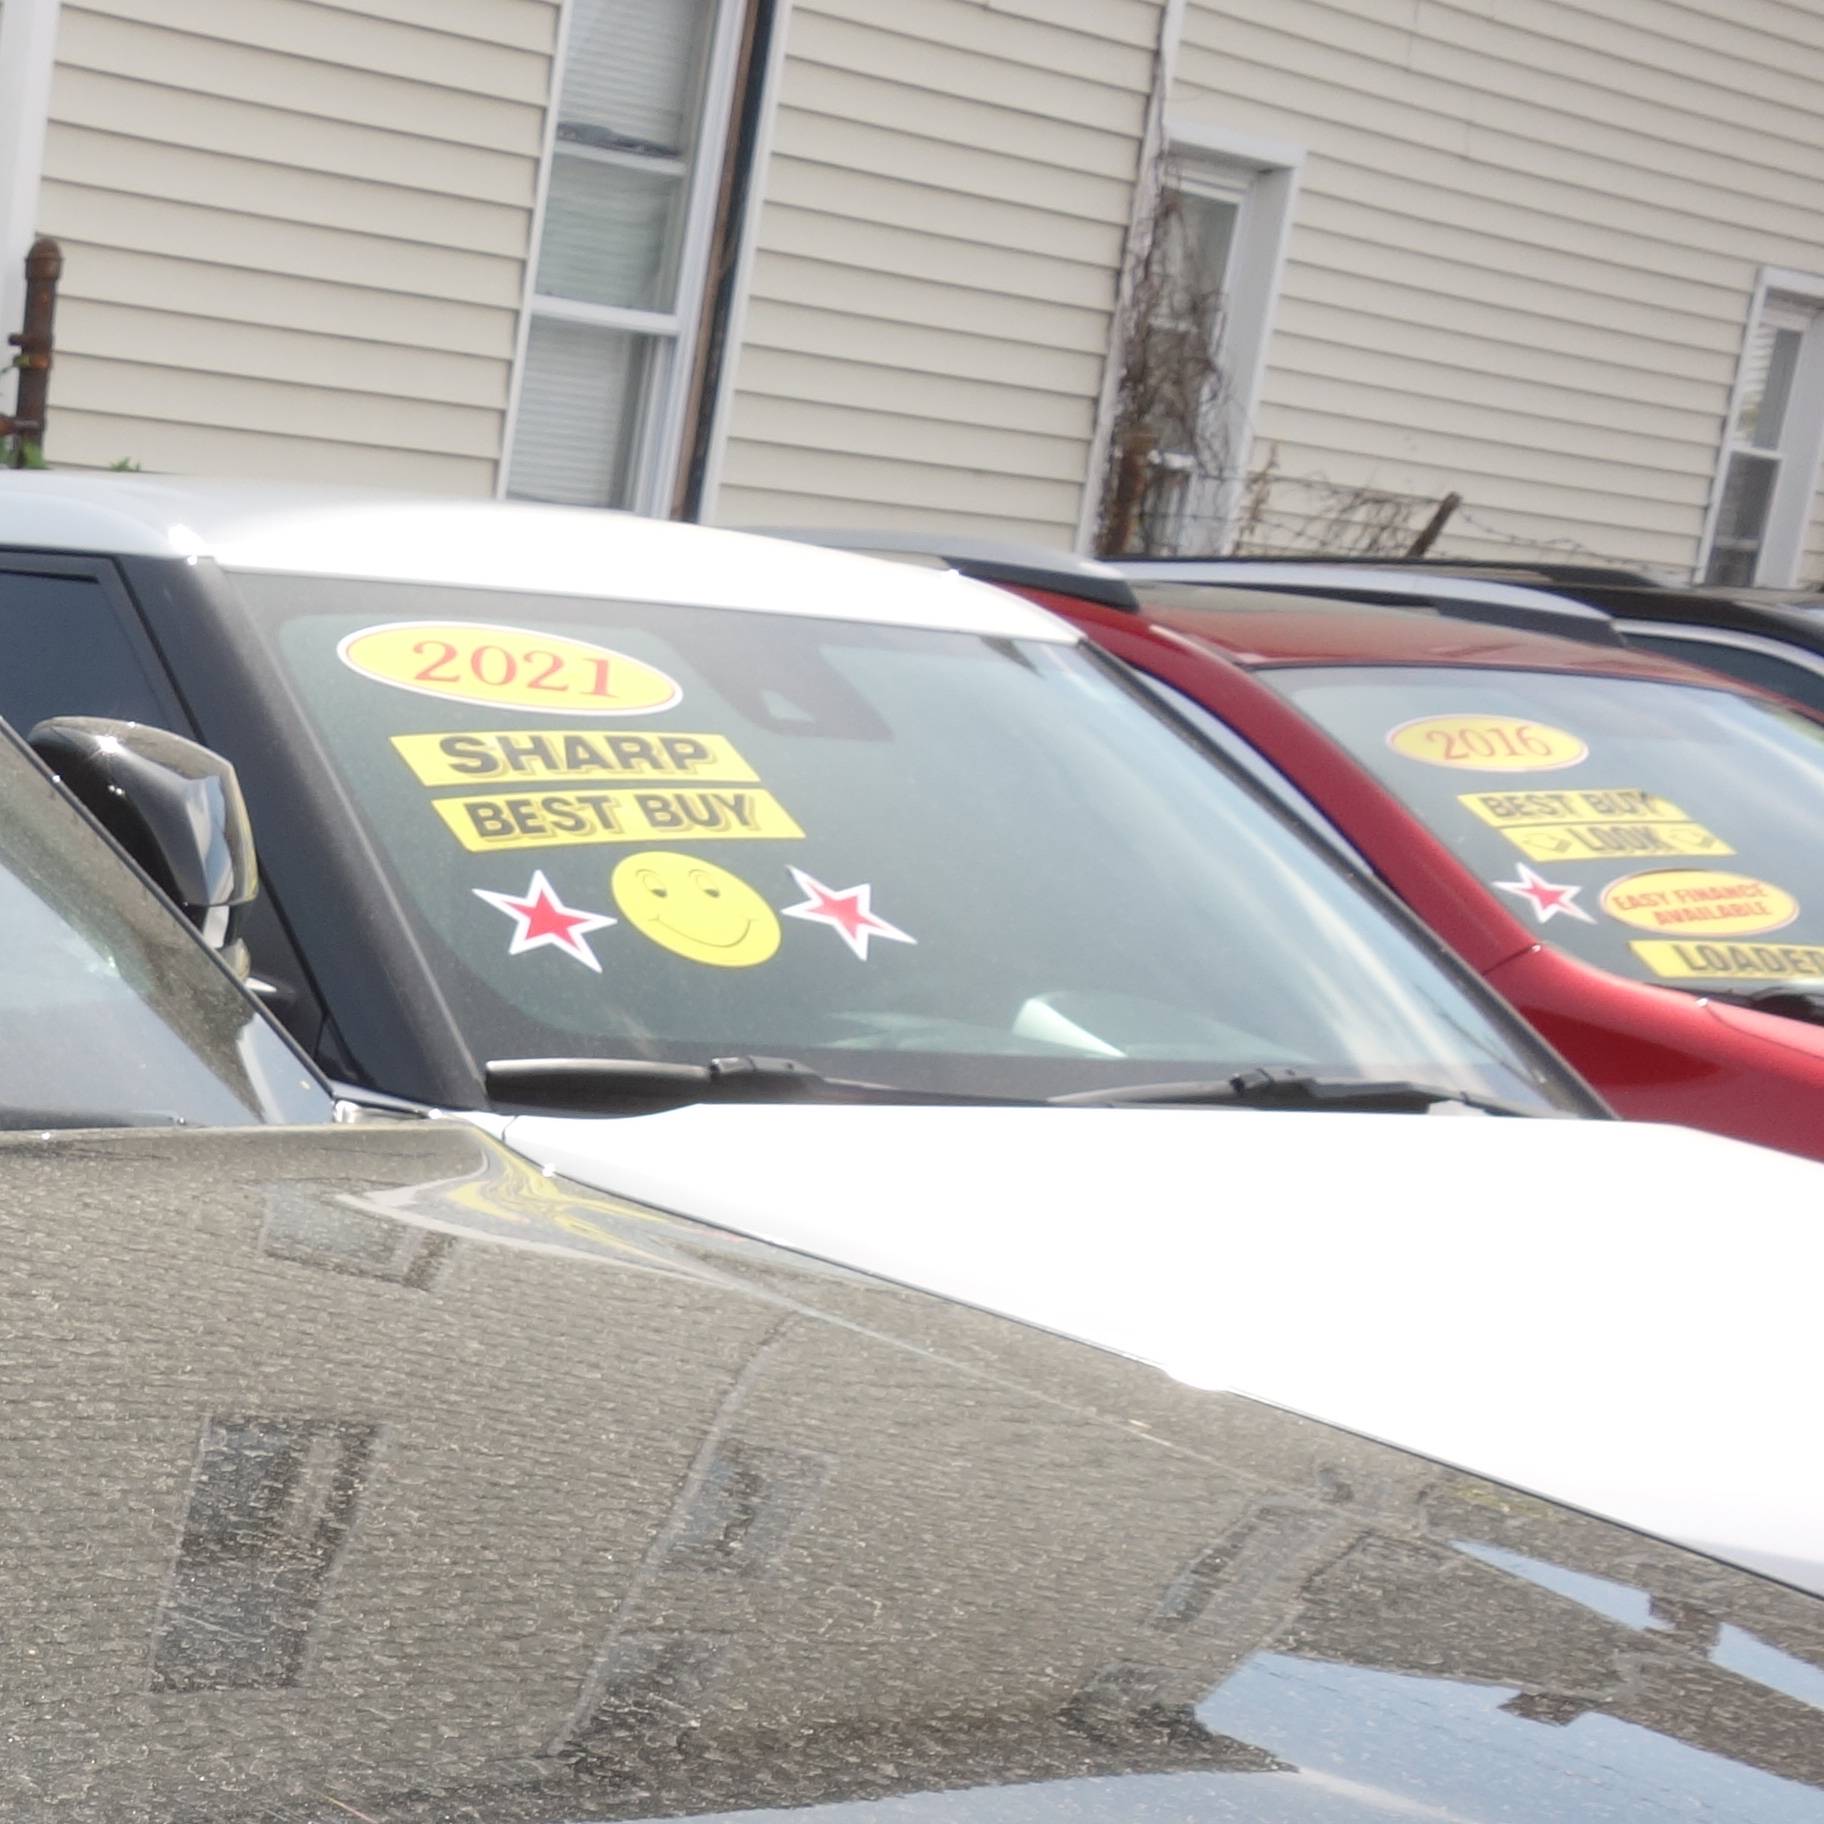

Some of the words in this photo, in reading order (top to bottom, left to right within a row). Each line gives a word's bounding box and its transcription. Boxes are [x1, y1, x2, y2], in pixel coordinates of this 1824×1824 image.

[412, 641, 618, 700] 2021
[439, 735, 714, 775] SHARP
[1426, 726, 1552, 760] 2016
[462, 796, 626, 841] BEST
[633, 794, 764, 830] BUY
[1478, 793, 1578, 818] BEST
[1613, 891, 1671, 911] EASY
[1674, 882, 1769, 904] FINANCE
[1654, 902, 1771, 926] AVAILABLE
